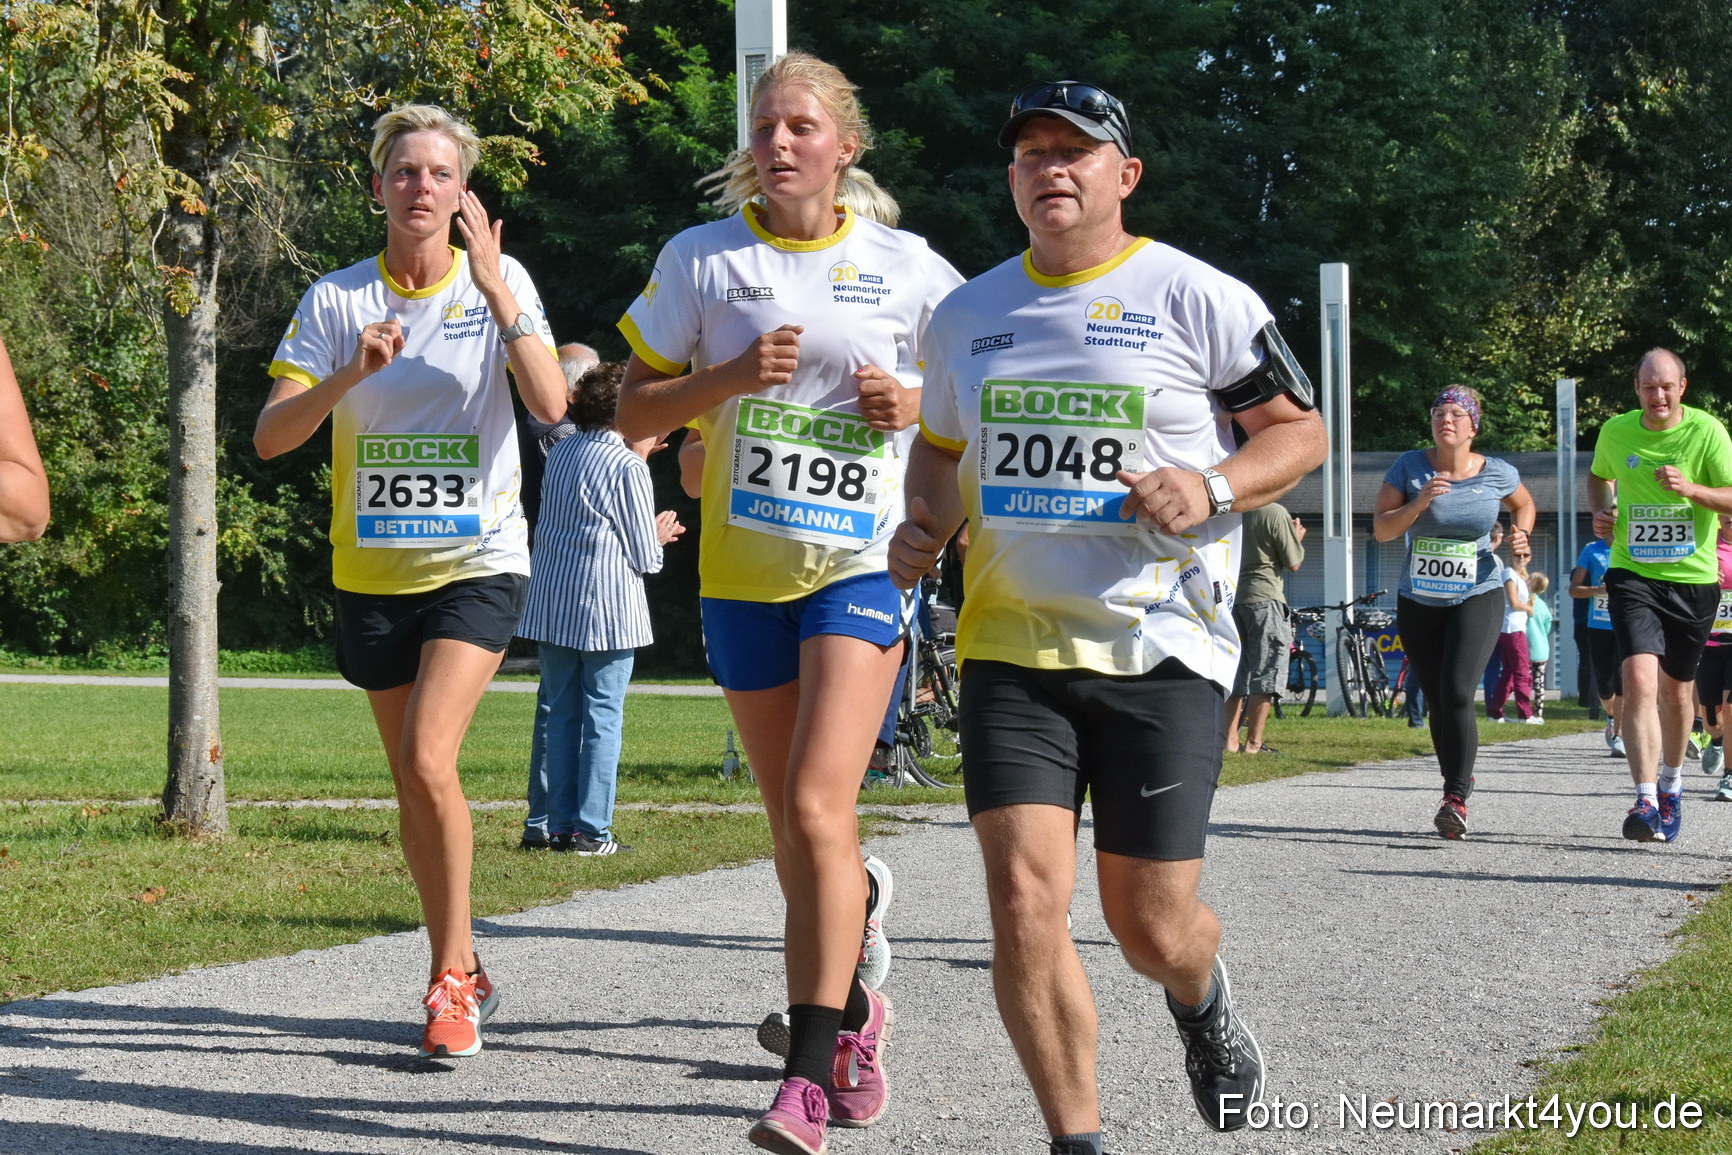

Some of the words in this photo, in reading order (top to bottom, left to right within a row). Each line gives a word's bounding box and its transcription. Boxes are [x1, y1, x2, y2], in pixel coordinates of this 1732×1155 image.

[832, 266, 858, 282] 20
[861, 274, 882, 284] JAHRE
[727, 287, 774, 299] BOCK
[833, 284, 892, 296] Neumarkter
[833, 294, 881, 306] Stadtlauf
[443, 303, 464, 320] 20
[1088, 302, 1121, 321] 20
[1125, 313, 1153, 324] JAHRE
[444, 327, 485, 341] Stadtlauf
[1086, 322, 1164, 340] Neumarkter
[971, 333, 1015, 352] BOCK
[1084, 335, 1147, 351] Stadtlauf
[991, 385, 1132, 424] BOCK
[748, 403, 876, 452] BOCK
[364, 438, 470, 464] BOCK
[995, 432, 1124, 482] 2048
[1128, 442, 1136, 451] D
[747, 446, 868, 502] 2198
[871, 469, 879, 477] D
[368, 473, 465, 508] 2633
[1004, 490, 1104, 517] JÜRGEN
[748, 499, 855, 534] JOHANNA
[1632, 506, 1690, 520] BOCK
[374, 519, 458, 535] BETTINA
[1635, 524, 1686, 542] 2233
[1417, 540, 1470, 557] BOCK
[1633, 547, 1689, 556] CHRISTIAN
[1178, 565, 1201, 584] 2019
[1417, 557, 1468, 579] 2004
[1416, 580, 1467, 591] FRANZISKA
[847, 602, 894, 625] hummel
